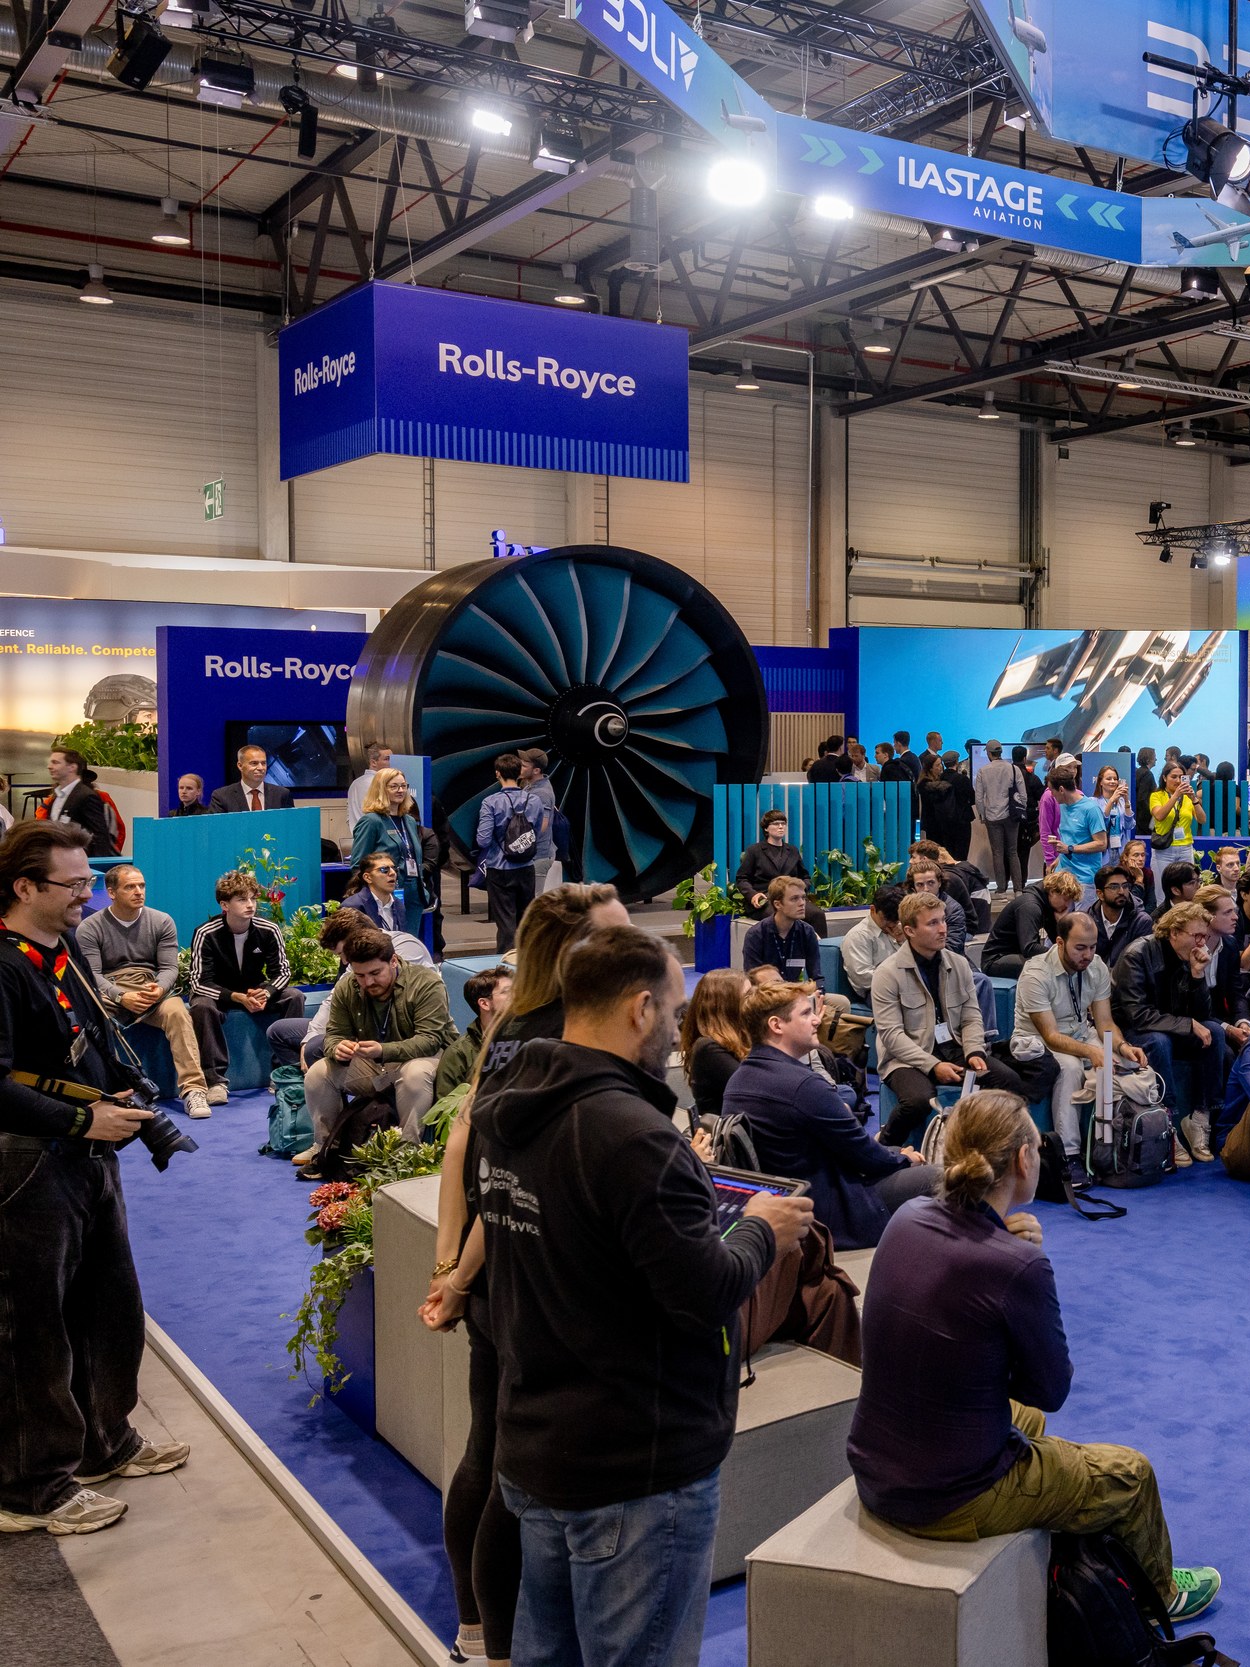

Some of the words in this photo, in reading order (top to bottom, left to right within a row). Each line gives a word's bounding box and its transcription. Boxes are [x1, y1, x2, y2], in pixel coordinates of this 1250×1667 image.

[973, 206, 1042, 230] AVIATION
[294, 351, 356, 396] Rolls-Royce
[438, 342, 636, 399] Rolls-Royce
[26, 643, 88, 655] Reliable.
[91, 645, 156, 658] Compete
